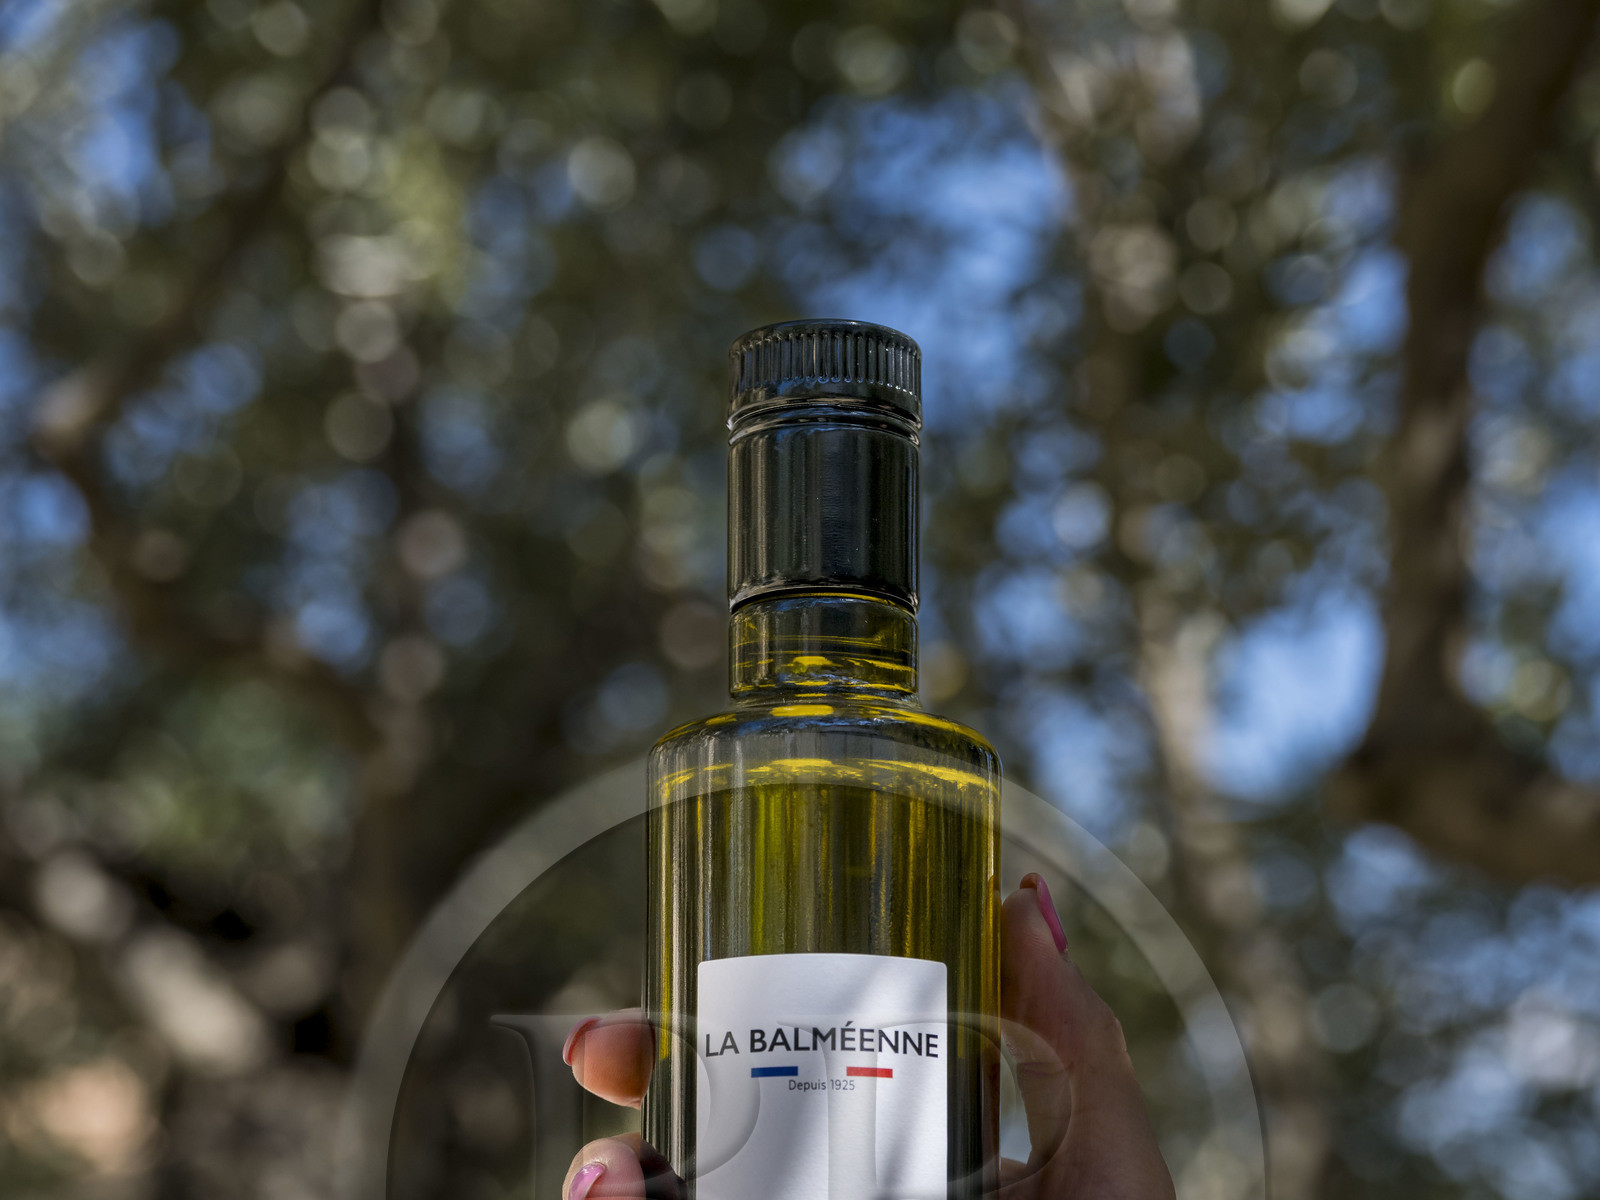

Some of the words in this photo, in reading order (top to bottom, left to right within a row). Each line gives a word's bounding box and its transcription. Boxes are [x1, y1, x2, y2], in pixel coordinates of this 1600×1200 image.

[705, 1030, 740, 1058] LA
[749, 1020, 939, 1058] BALMÉENNE
[788, 1079, 827, 1092] Depuis
[830, 1079, 856, 1091] 1925
